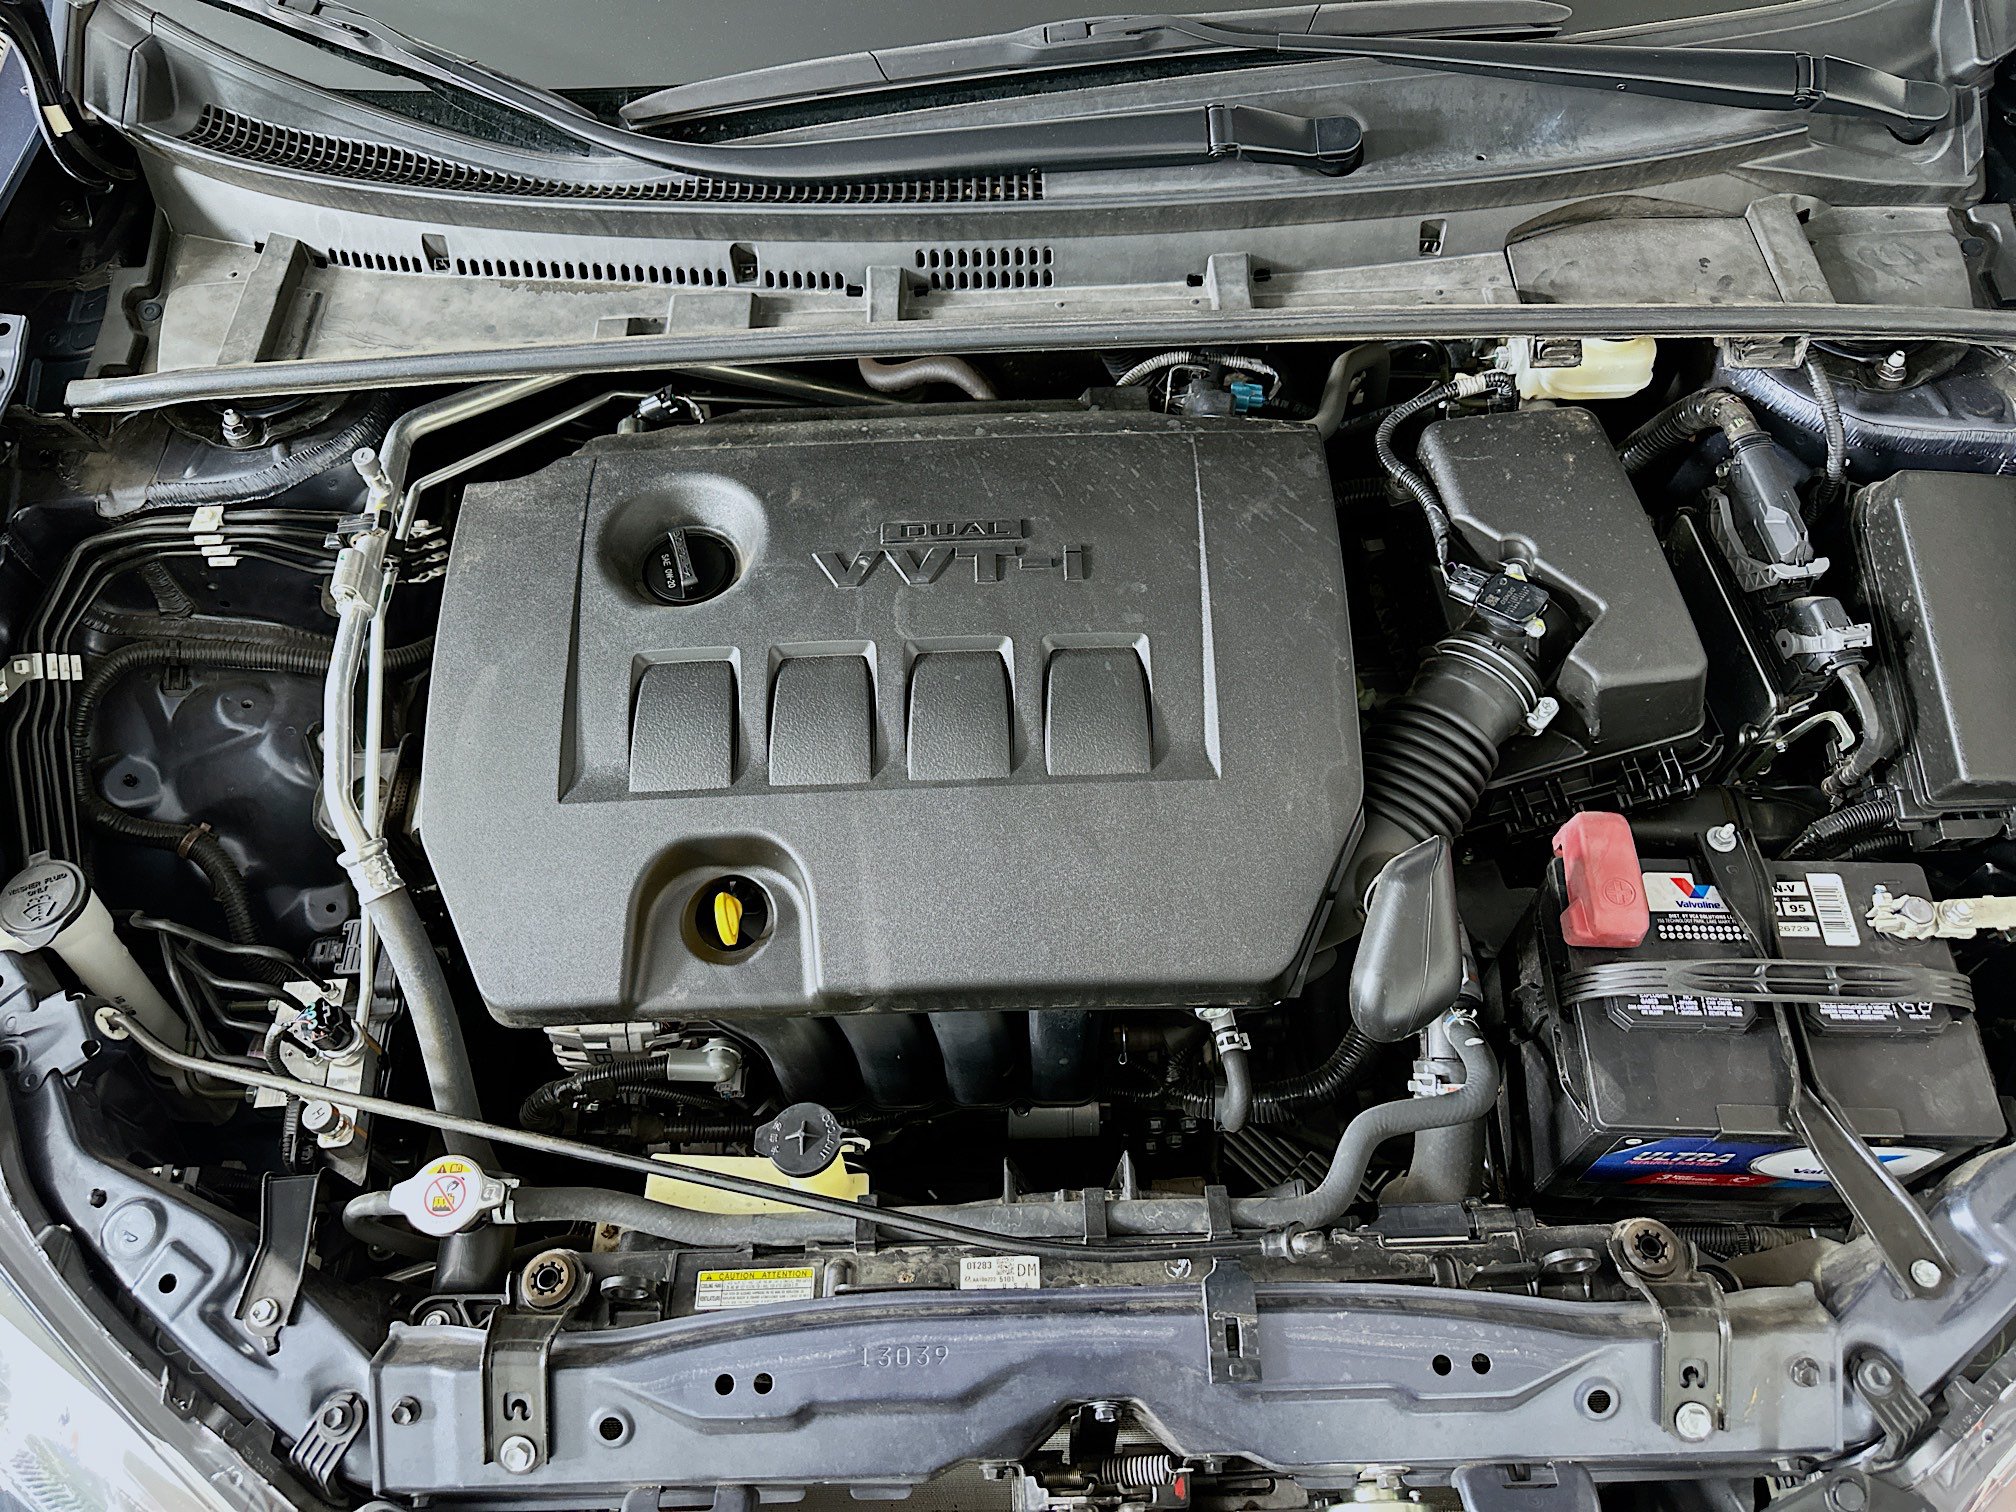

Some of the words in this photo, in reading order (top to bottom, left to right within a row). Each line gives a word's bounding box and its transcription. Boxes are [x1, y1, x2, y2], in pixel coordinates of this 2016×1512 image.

[900, 522, 1012, 538] DUAL
[661, 553, 671, 567] SAE
[665, 568, 676, 589] 0W-20
[8, 881, 41, 896] WASHER
[45, 873, 68, 884] FLUID
[27, 885, 48, 896] ONLY
[1676, 900, 1721, 909] Valvoline
[1789, 904, 1806, 913] 95
[1633, 1151, 1736, 1163] ULTRA
[718, 1273, 755, 1281] CAUTION
[761, 1270, 808, 1279] ATTENTION
[1017, 1263, 1037, 1277] DM
[861, 1345, 950, 1368] 13039
